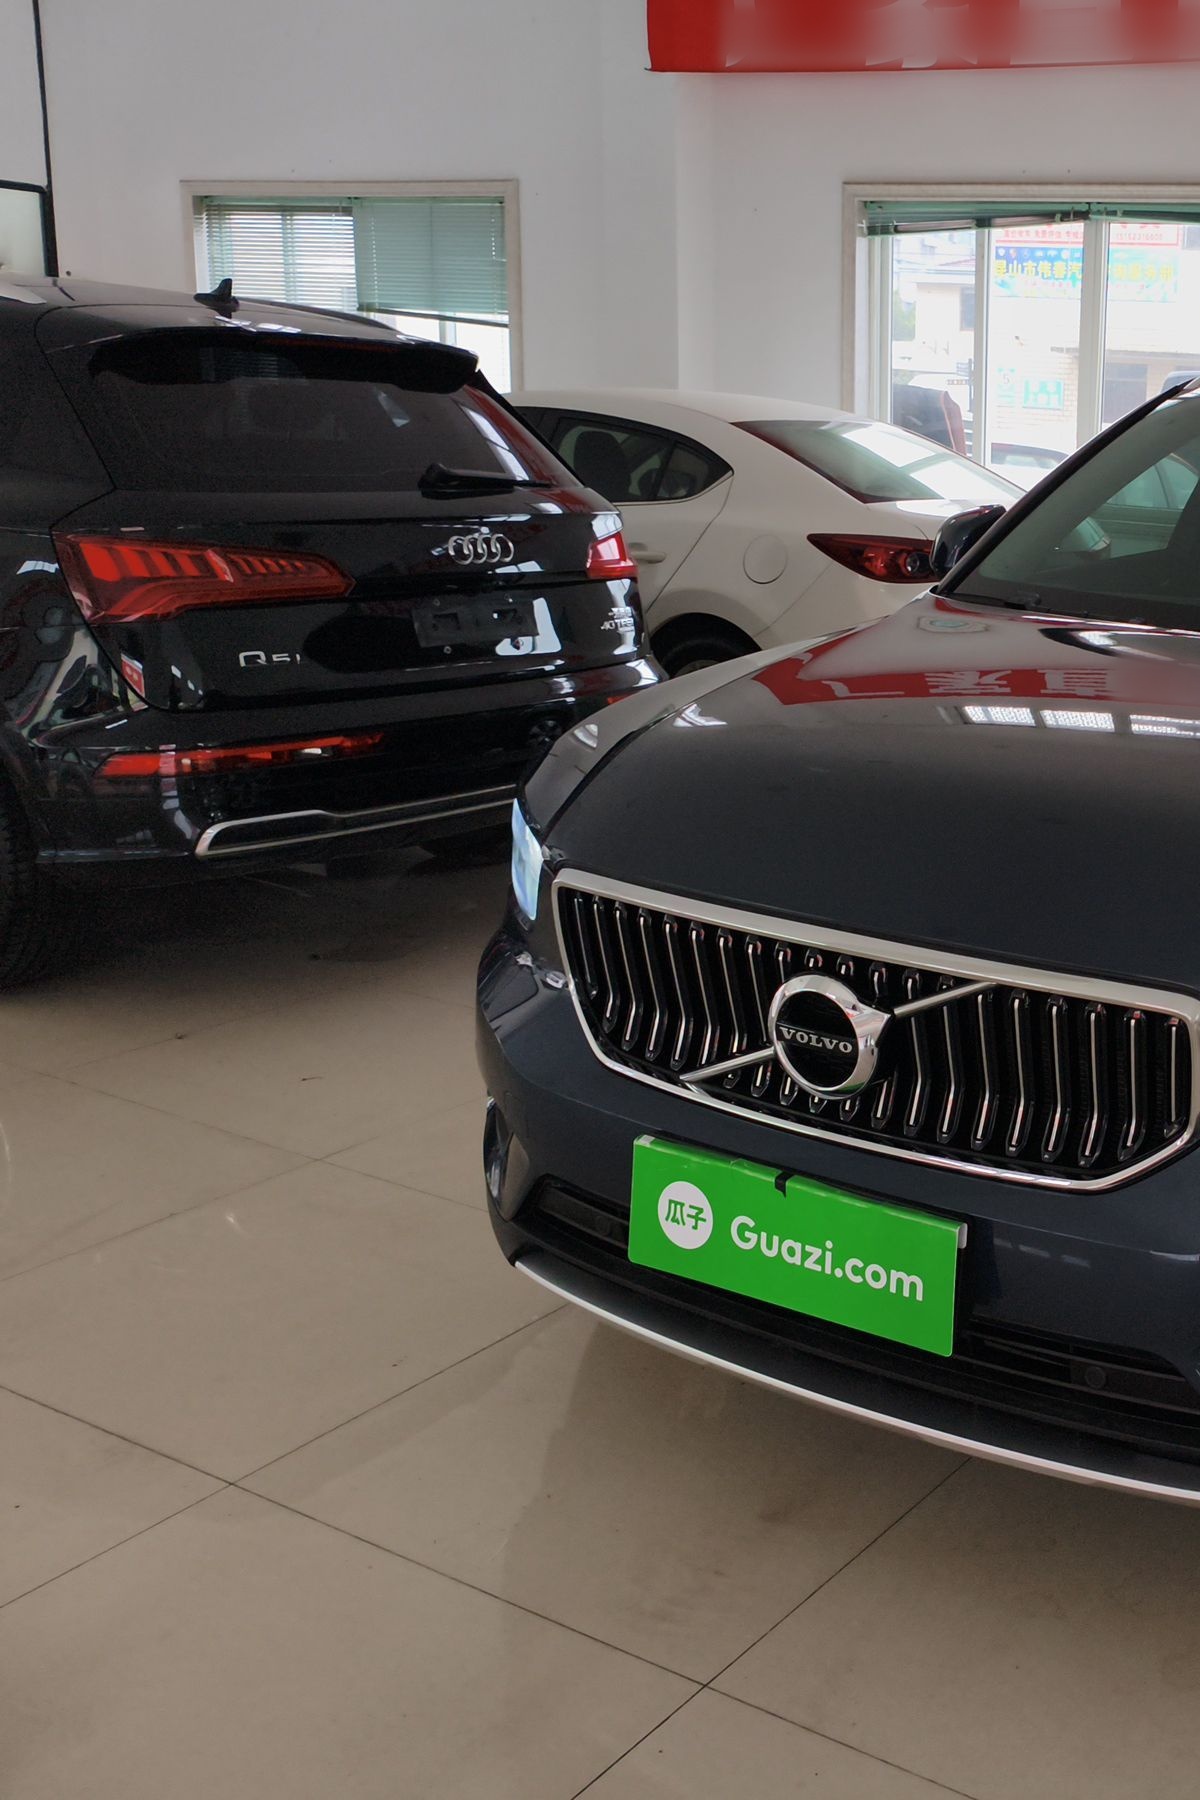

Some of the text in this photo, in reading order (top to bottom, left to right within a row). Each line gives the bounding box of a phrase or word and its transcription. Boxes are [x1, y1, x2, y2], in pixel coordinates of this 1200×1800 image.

[779, 1026, 853, 1053] VOLVO
[664, 1198, 708, 1231] 瓜子
[730, 1215, 924, 1302] Guazi.com
